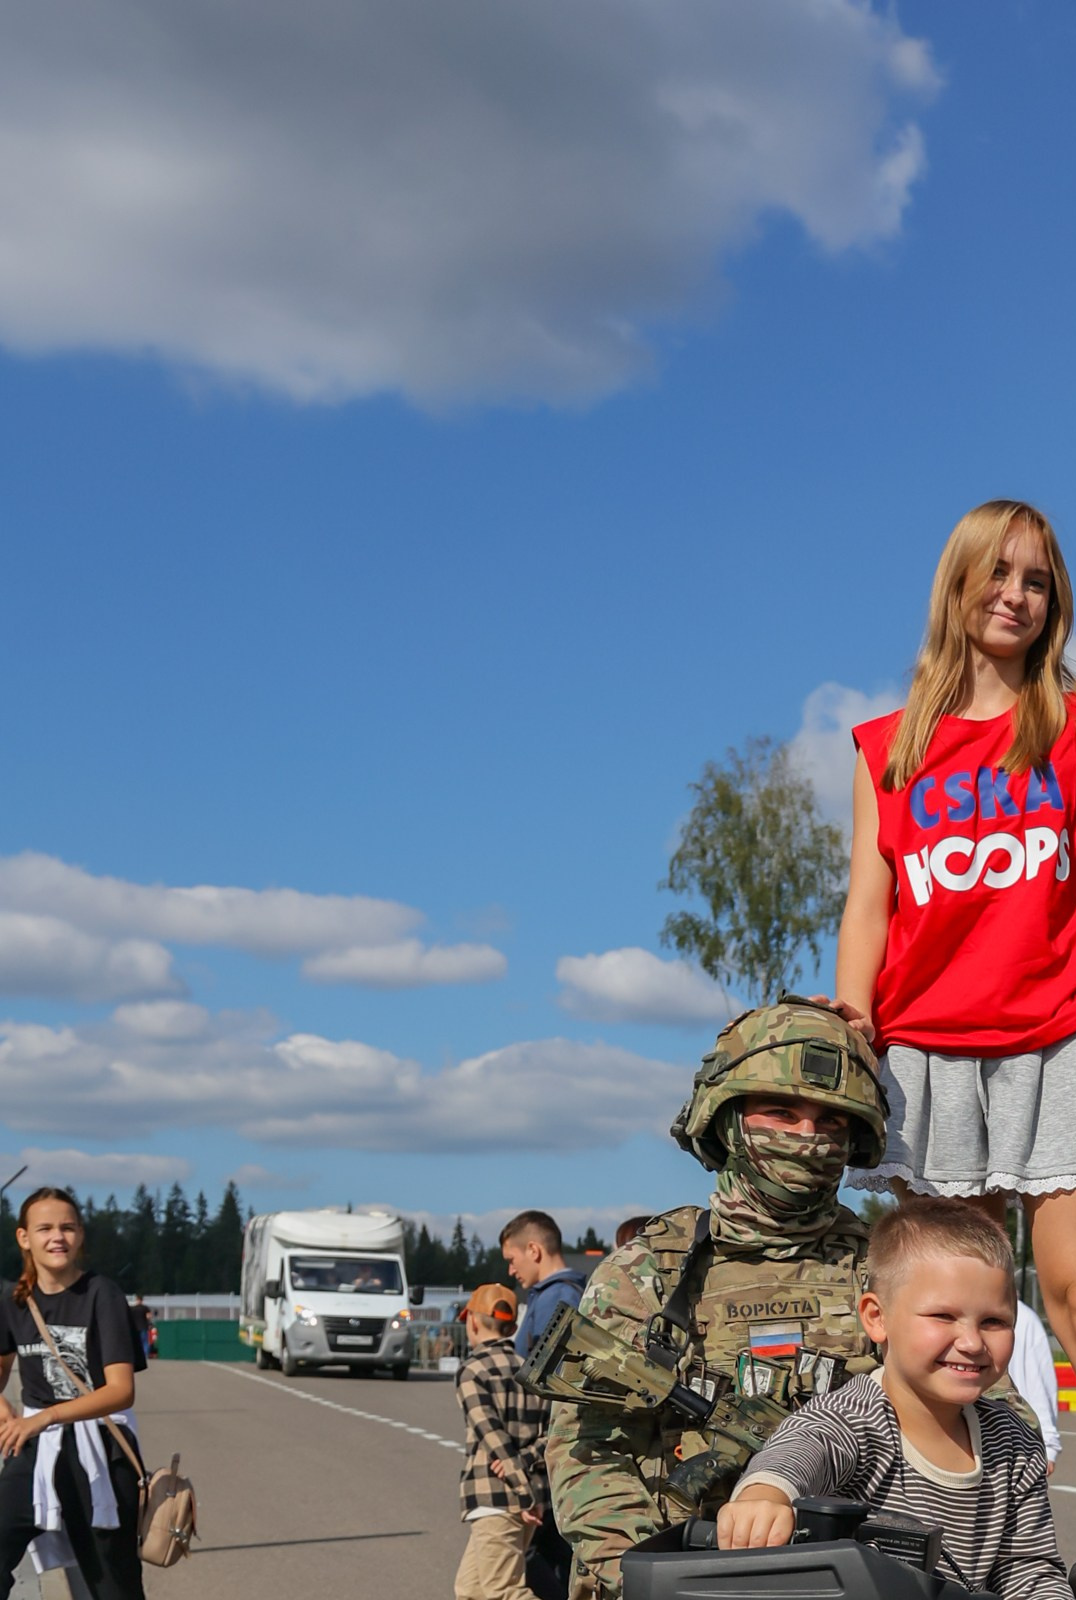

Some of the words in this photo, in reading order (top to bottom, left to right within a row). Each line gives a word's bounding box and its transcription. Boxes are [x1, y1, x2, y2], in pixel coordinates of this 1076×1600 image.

[910, 762, 1064, 828] CSKA
[904, 826, 1071, 906] HOOPS
[727, 1300, 814, 1319] ВОРКУТА
